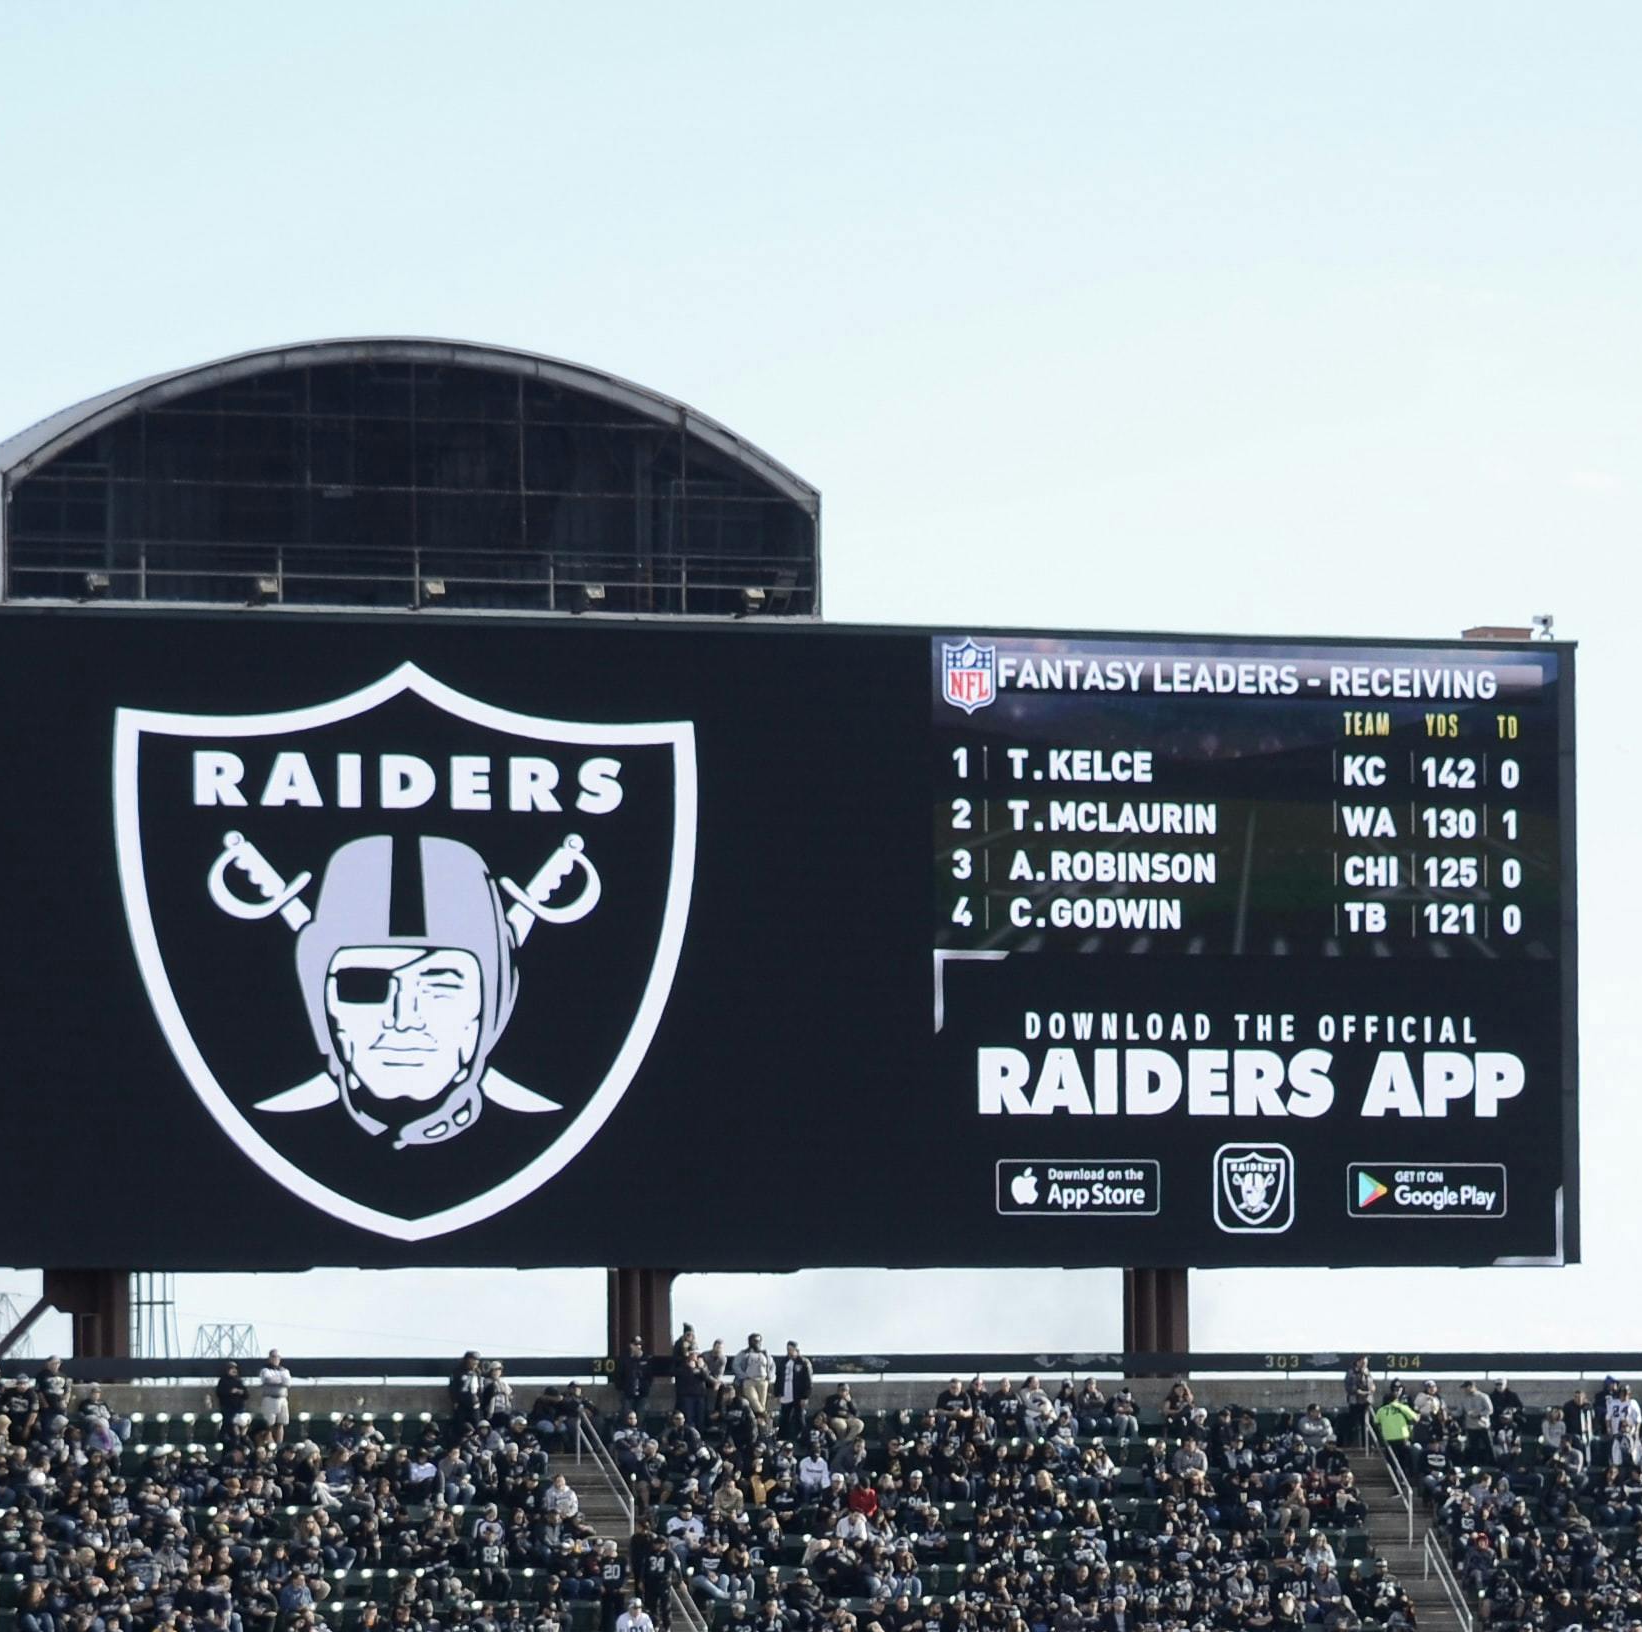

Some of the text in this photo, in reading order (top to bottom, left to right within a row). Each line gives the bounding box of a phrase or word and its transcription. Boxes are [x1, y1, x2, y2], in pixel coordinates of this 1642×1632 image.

[950, 671, 989, 701] NFL
[998, 659, 1145, 693] FANTASY
[1153, 662, 1300, 695] LEADERS
[1329, 666, 1497, 700] RECEIVING
[1343, 711, 1518, 739] TEAM YDS TD
[193, 750, 624, 815] RAIDERS
[952, 747, 968, 778] 1
[1343, 755, 1386, 787] KC
[1422, 757, 1476, 789] 142
[1500, 759, 1520, 789] 0
[952, 798, 972, 829] 2
[1341, 806, 1397, 838] WA
[1422, 807, 1476, 839] 130
[1502, 809, 1517, 840] 1
[952, 848, 972, 880] 3
[1344, 855, 1399, 887] CHI
[1424, 856, 1478, 888] 125
[1502, 858, 1521, 889] 0
[951, 896, 973, 927] 4
[1344, 902, 1387, 933] TB
[1424, 903, 1475, 935] 121
[1502, 904, 1522, 935] 0
[1025, 1011, 1477, 1044] DOWNLOAD THE OFFICIAL
[977, 1047, 1526, 1118] RAIDERS APP
[1048, 1168, 1144, 1180] Download on the
[1395, 1171, 1443, 1183] GET IT ON
[1047, 1183, 1145, 1210] App Store
[1395, 1185, 1496, 1211] Google Play
[1265, 1355, 1299, 1369] 303
[1387, 1355, 1420, 1368] 304
[1611, 1404, 1629, 1420] 24
[649, 1555, 665, 1573] 34
